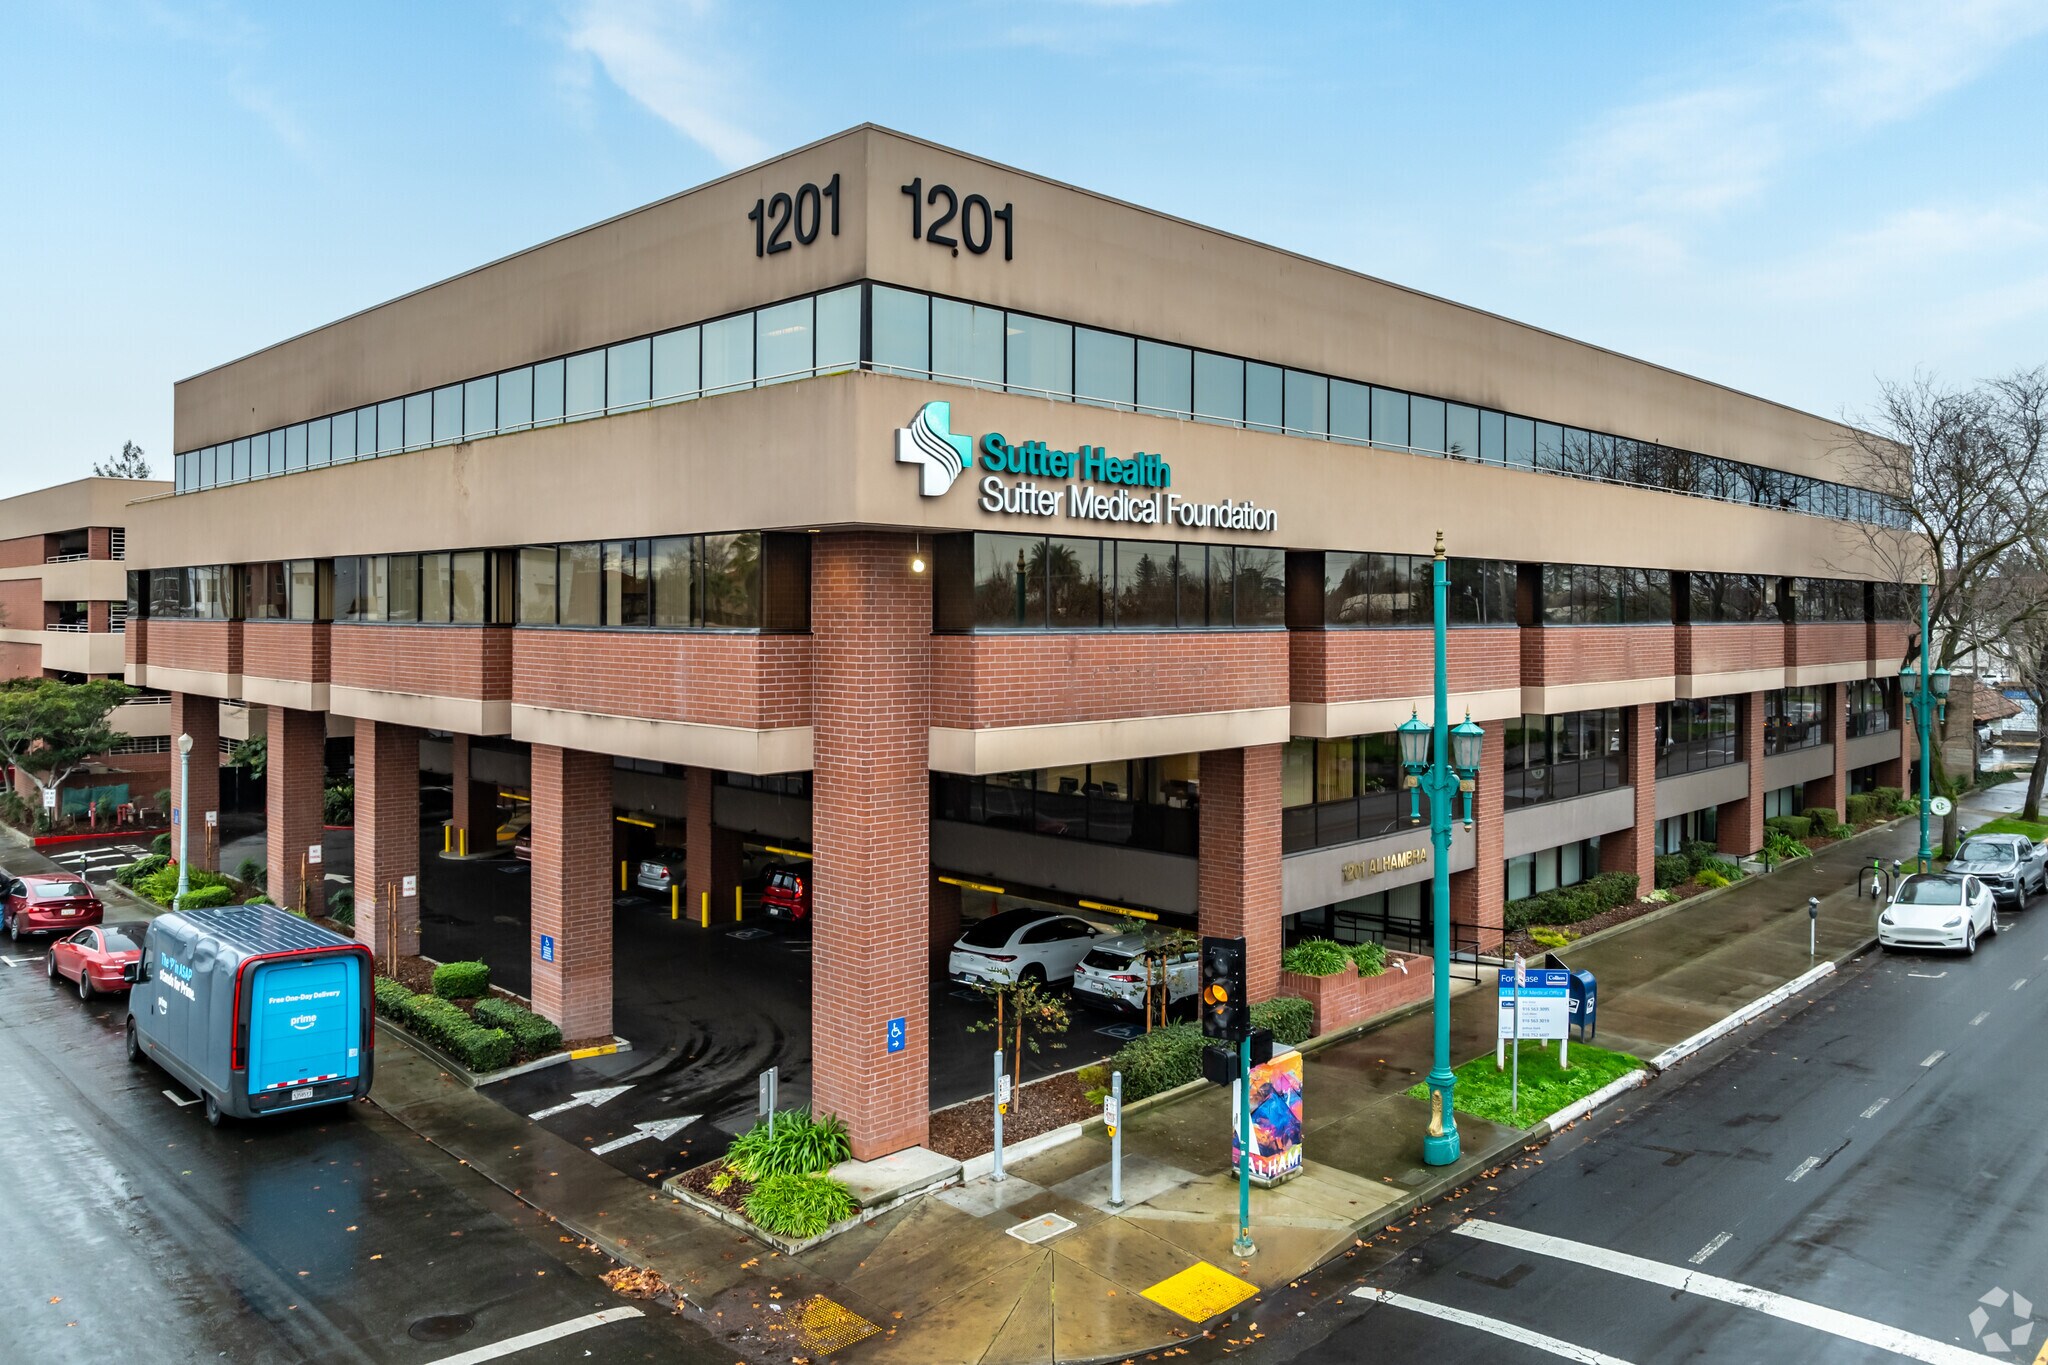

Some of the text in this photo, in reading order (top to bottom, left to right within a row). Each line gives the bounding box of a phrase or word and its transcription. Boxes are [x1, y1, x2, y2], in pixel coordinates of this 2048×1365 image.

[748, 173, 840, 257] 1201
[901, 177, 1013, 262] 1201
[979, 432, 1171, 488] Sutter Health
[979, 476, 1278, 532] Sutter Medical Foundation
[1342, 847, 1427, 882] 1201 ALHAMBRA
[161, 952, 169, 968] The
[179, 963, 193, 981] ASAP
[1501, 974, 1514, 983] For
[269, 990, 341, 1005] Free One-Day Delivery
[290, 1014, 317, 1027] prime
